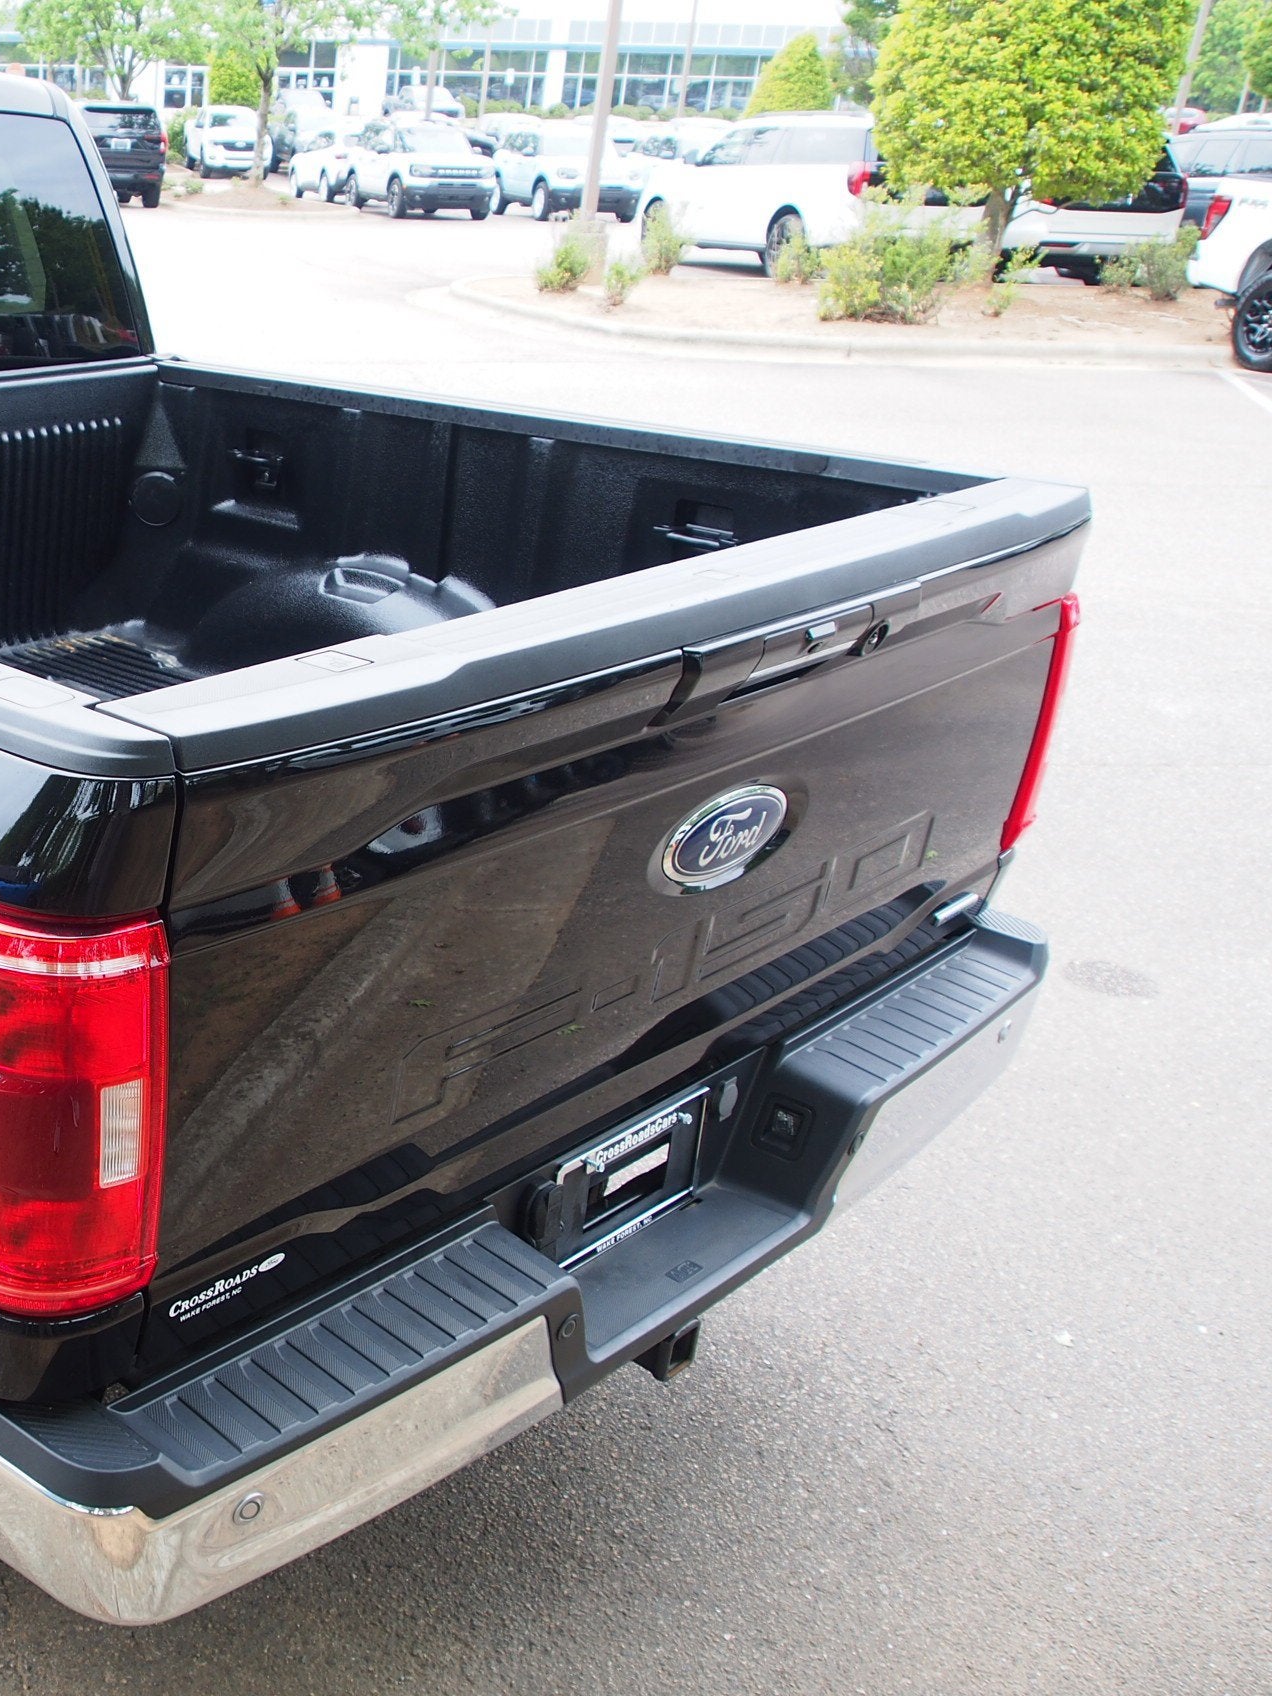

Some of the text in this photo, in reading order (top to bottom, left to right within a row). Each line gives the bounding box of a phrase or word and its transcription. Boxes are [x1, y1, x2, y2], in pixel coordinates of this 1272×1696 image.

[698, 807, 768, 867] Ford
[596, 1112, 678, 1164] CrossRoadsCars
[596, 1235, 615, 1253] WAKE
[643, 1215, 653, 1226] NC
[180, 1306, 200, 1322] WAKE
[232, 1286, 242, 1296] NC
